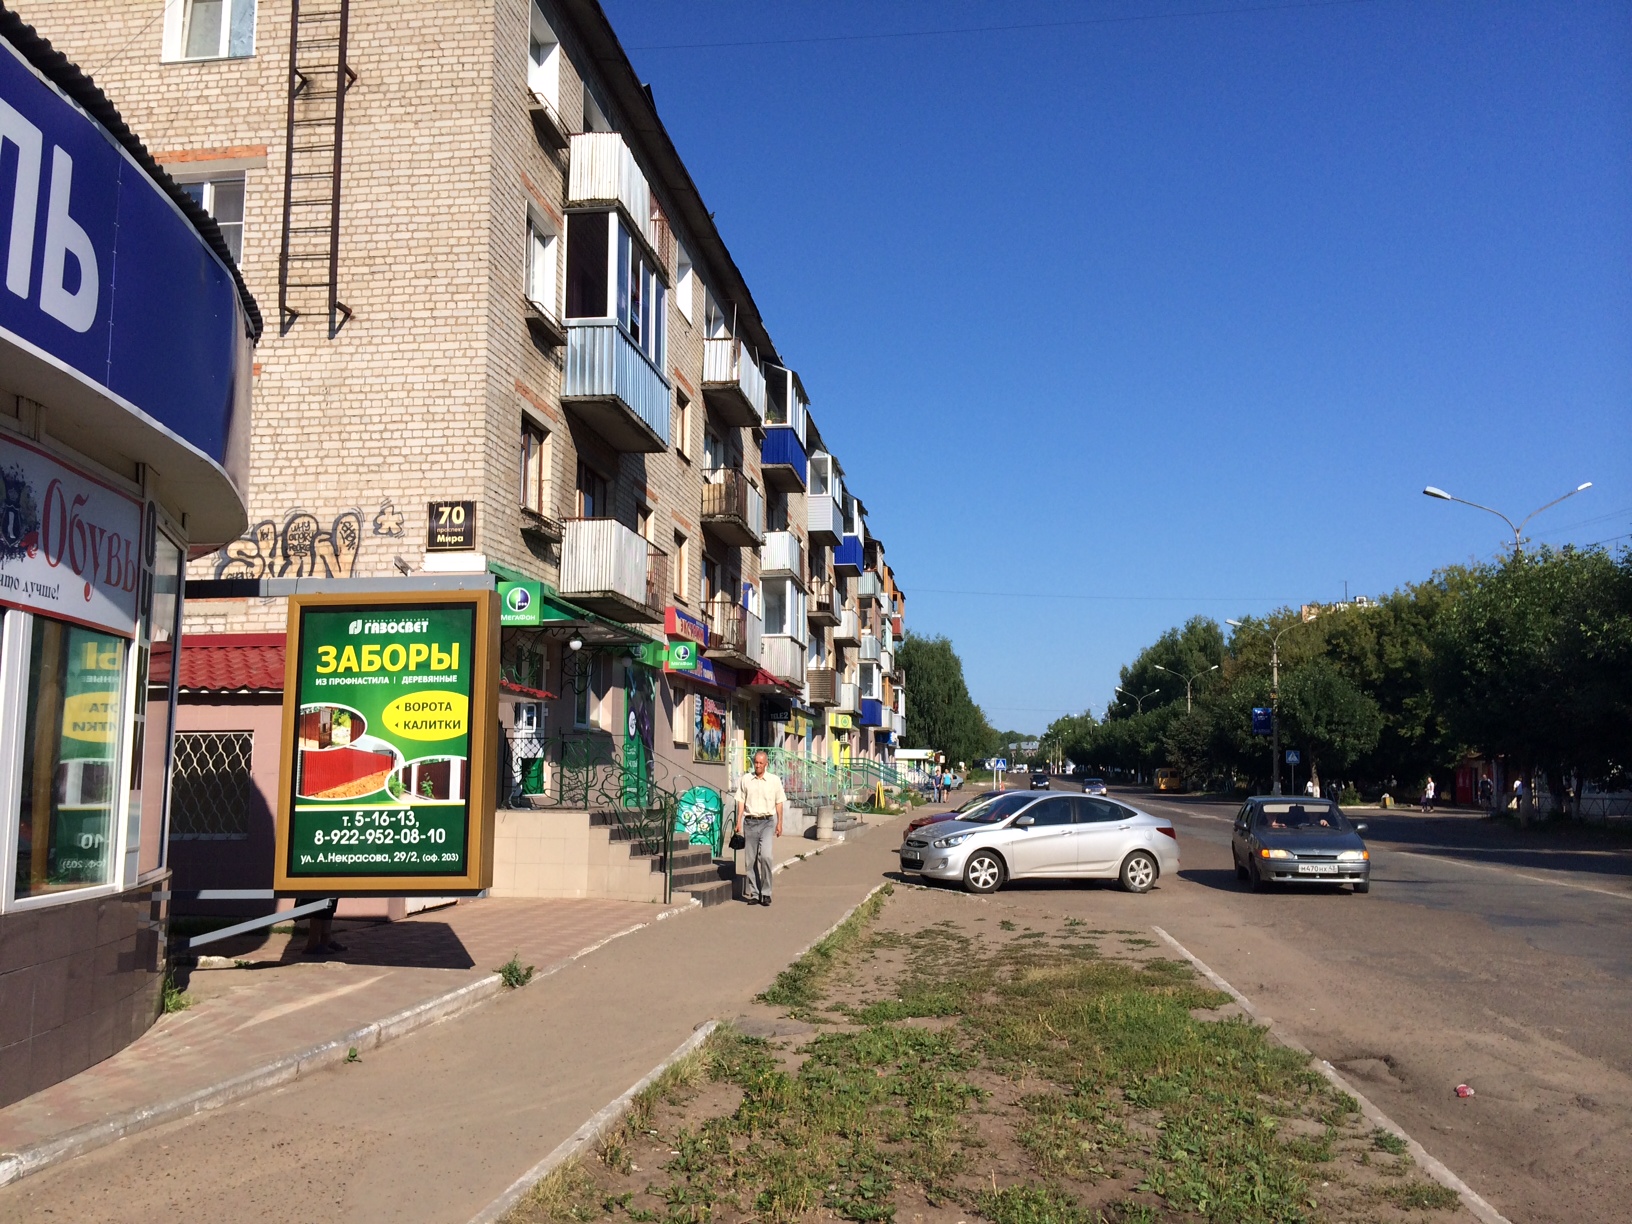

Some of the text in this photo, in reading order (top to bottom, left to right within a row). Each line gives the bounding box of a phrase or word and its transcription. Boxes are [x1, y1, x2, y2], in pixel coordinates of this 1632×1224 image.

[438, 506, 465, 525] 70
[42, 478, 136, 602] Обувь
[437, 534, 464, 544] Мира
[22, 580, 60, 601] лучше!
[364, 621, 429, 634] ГАЗОСВЕТ
[130, 500, 157, 791] ОЧКИ
[316, 642, 460, 674] ЗАБОРЫ
[315, 675, 458, 686] ИЗ ПРОФНАСТИЛА ДЕРЕВЯННЫЕ
[404, 702, 452, 712] ВОРОТА
[770, 711, 789, 720] TELE2
[403, 719, 461, 730] КАЛИТКИ
[342, 811, 420, 828] т. 5-16-13,
[314, 828, 446, 845] 8-922-952-08-10
[300, 854, 315, 865] ул.
[393, 851, 420, 863] 29/2,
[422, 853, 440, 863] (оф.
[441, 853, 459, 862] 203)
